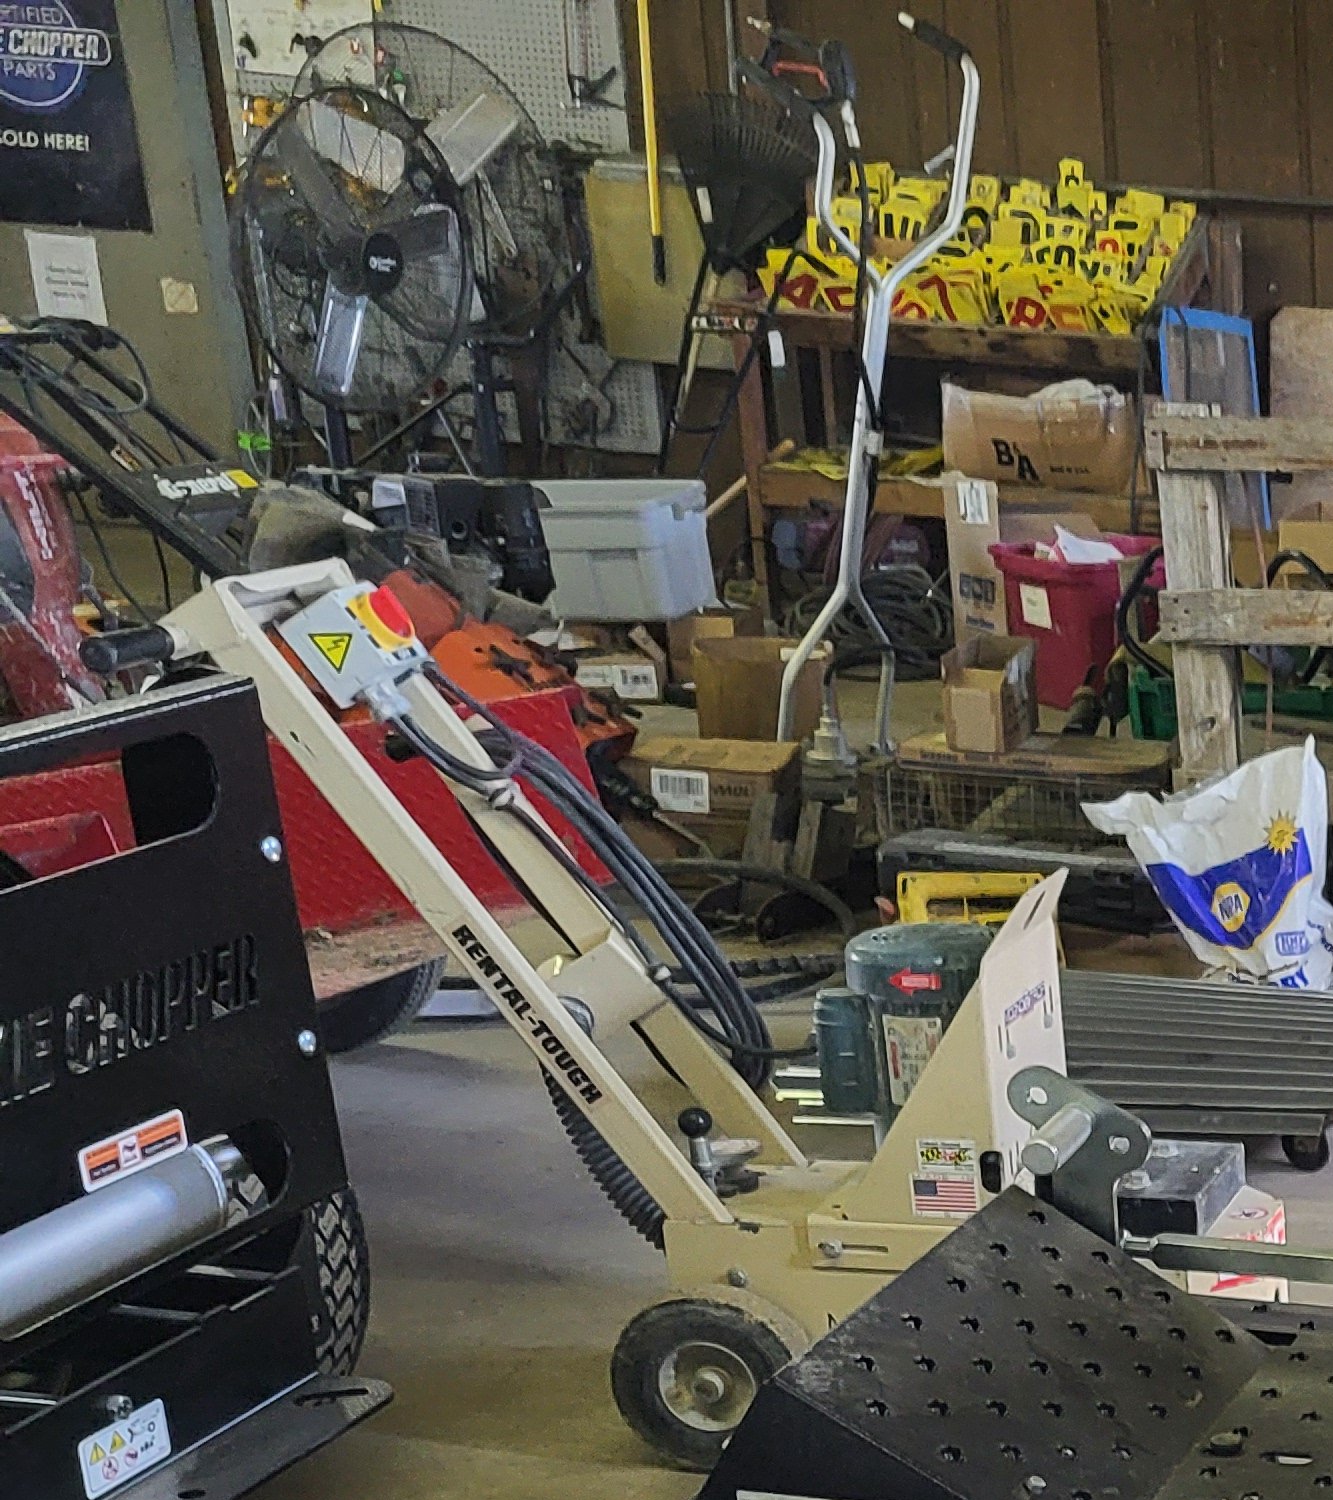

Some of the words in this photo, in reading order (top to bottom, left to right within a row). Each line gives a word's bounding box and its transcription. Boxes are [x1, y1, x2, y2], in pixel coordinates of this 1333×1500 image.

[8, 29, 99, 59] CHOPPER
[3, 60, 56, 81] PARTS
[0, 129, 39, 148] OLD
[43, 132, 90, 152] HERE!
[451, 923, 604, 1105] RENTAL-TOUGH
